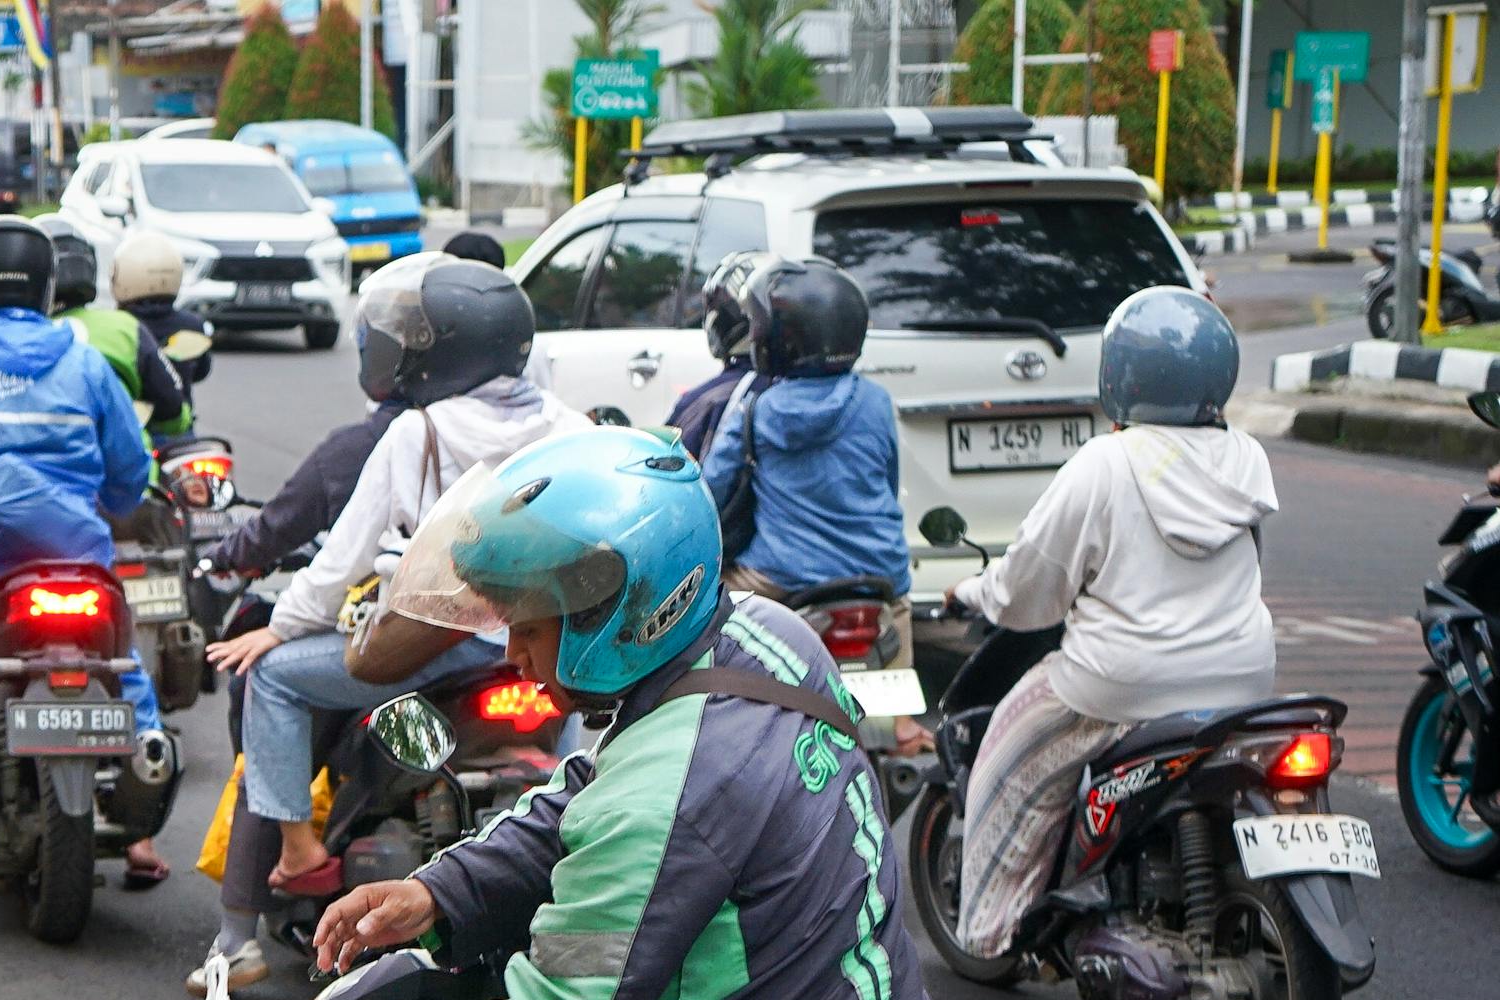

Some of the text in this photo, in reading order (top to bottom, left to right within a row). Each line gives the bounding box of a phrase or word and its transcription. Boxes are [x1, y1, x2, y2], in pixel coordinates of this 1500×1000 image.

[957, 420, 1087, 452] N 1459 HL
[14, 708, 27, 730] N
[90, 708, 126, 731] EDD
[1242, 821, 1373, 849] N 2416 EBC
